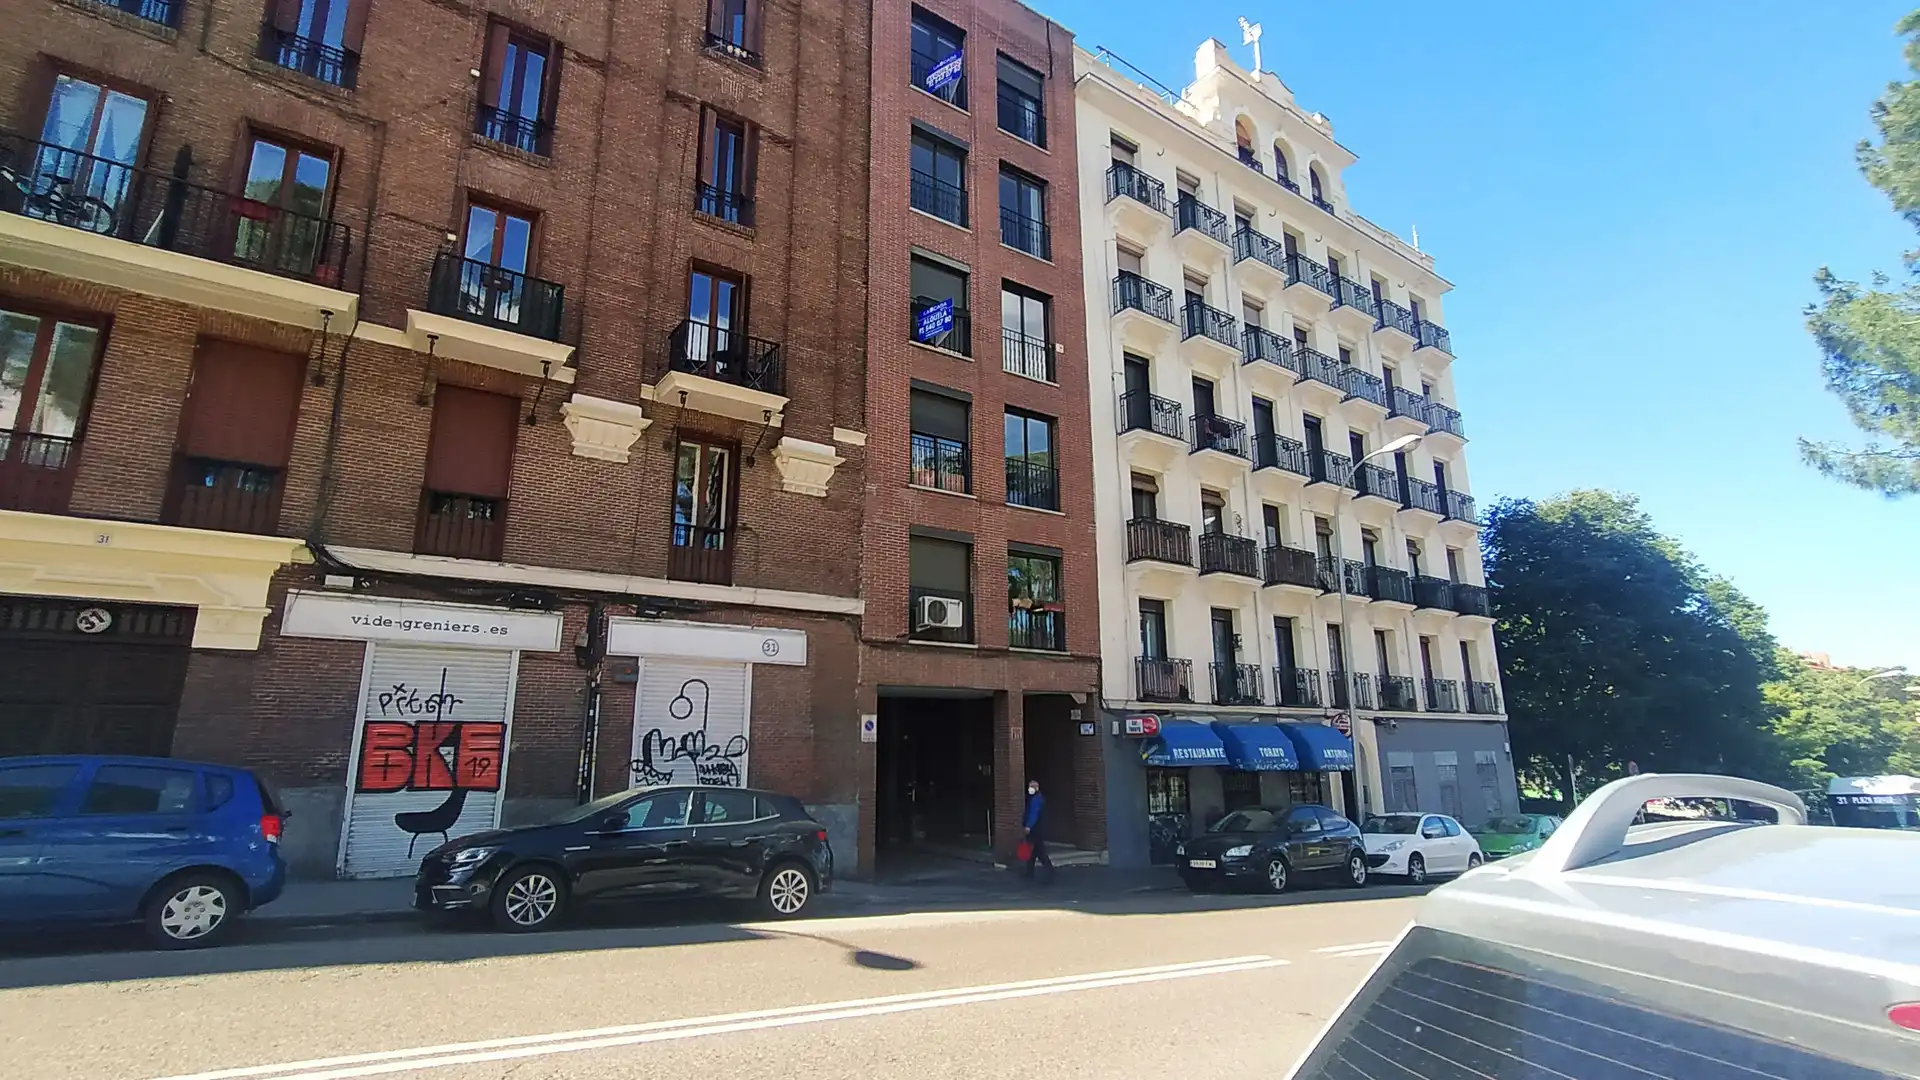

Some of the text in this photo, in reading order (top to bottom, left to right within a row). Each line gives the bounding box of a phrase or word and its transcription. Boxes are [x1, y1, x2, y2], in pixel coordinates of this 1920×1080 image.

[97, 534, 110, 545] 31
[79, 610, 106, 631] 31
[1172, 747, 1226, 759] RESTAURANTE
[464, 756, 491, 778] 19
